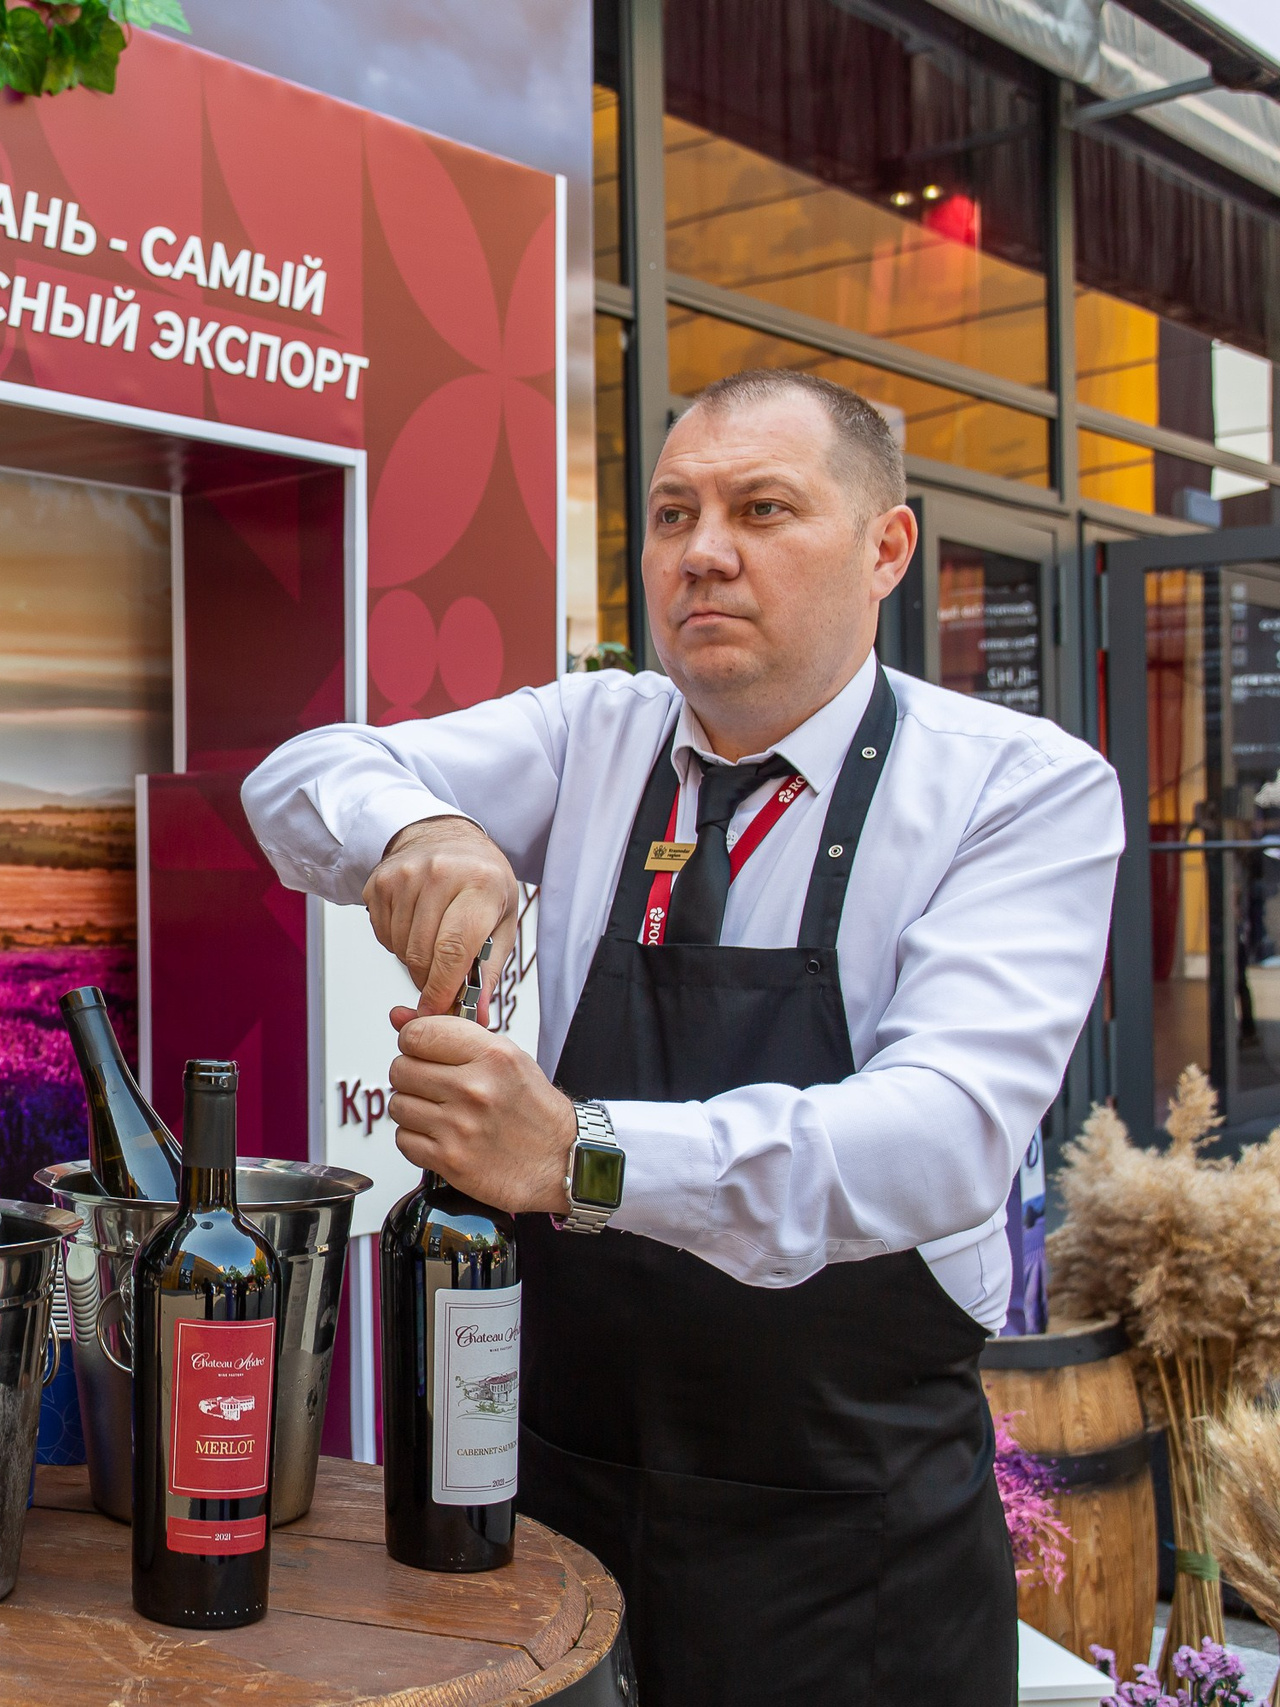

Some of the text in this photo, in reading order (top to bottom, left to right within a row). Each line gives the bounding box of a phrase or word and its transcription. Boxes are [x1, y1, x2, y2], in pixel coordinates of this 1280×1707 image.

[141, 226, 327, 316] САМЫЙ
[150, 310, 369, 400] ЭКСПОРТ
[339, 1079, 398, 1135] Кр
[455, 1324, 504, 1348] Chateau
[191, 1352, 233, 1371] Chateau
[195, 1440, 256, 1455] MERLOT
[456, 1447, 498, 1456] CABERNET
[492, 1478, 505, 1488] 2021
[214, 1533, 231, 1541] 2021
